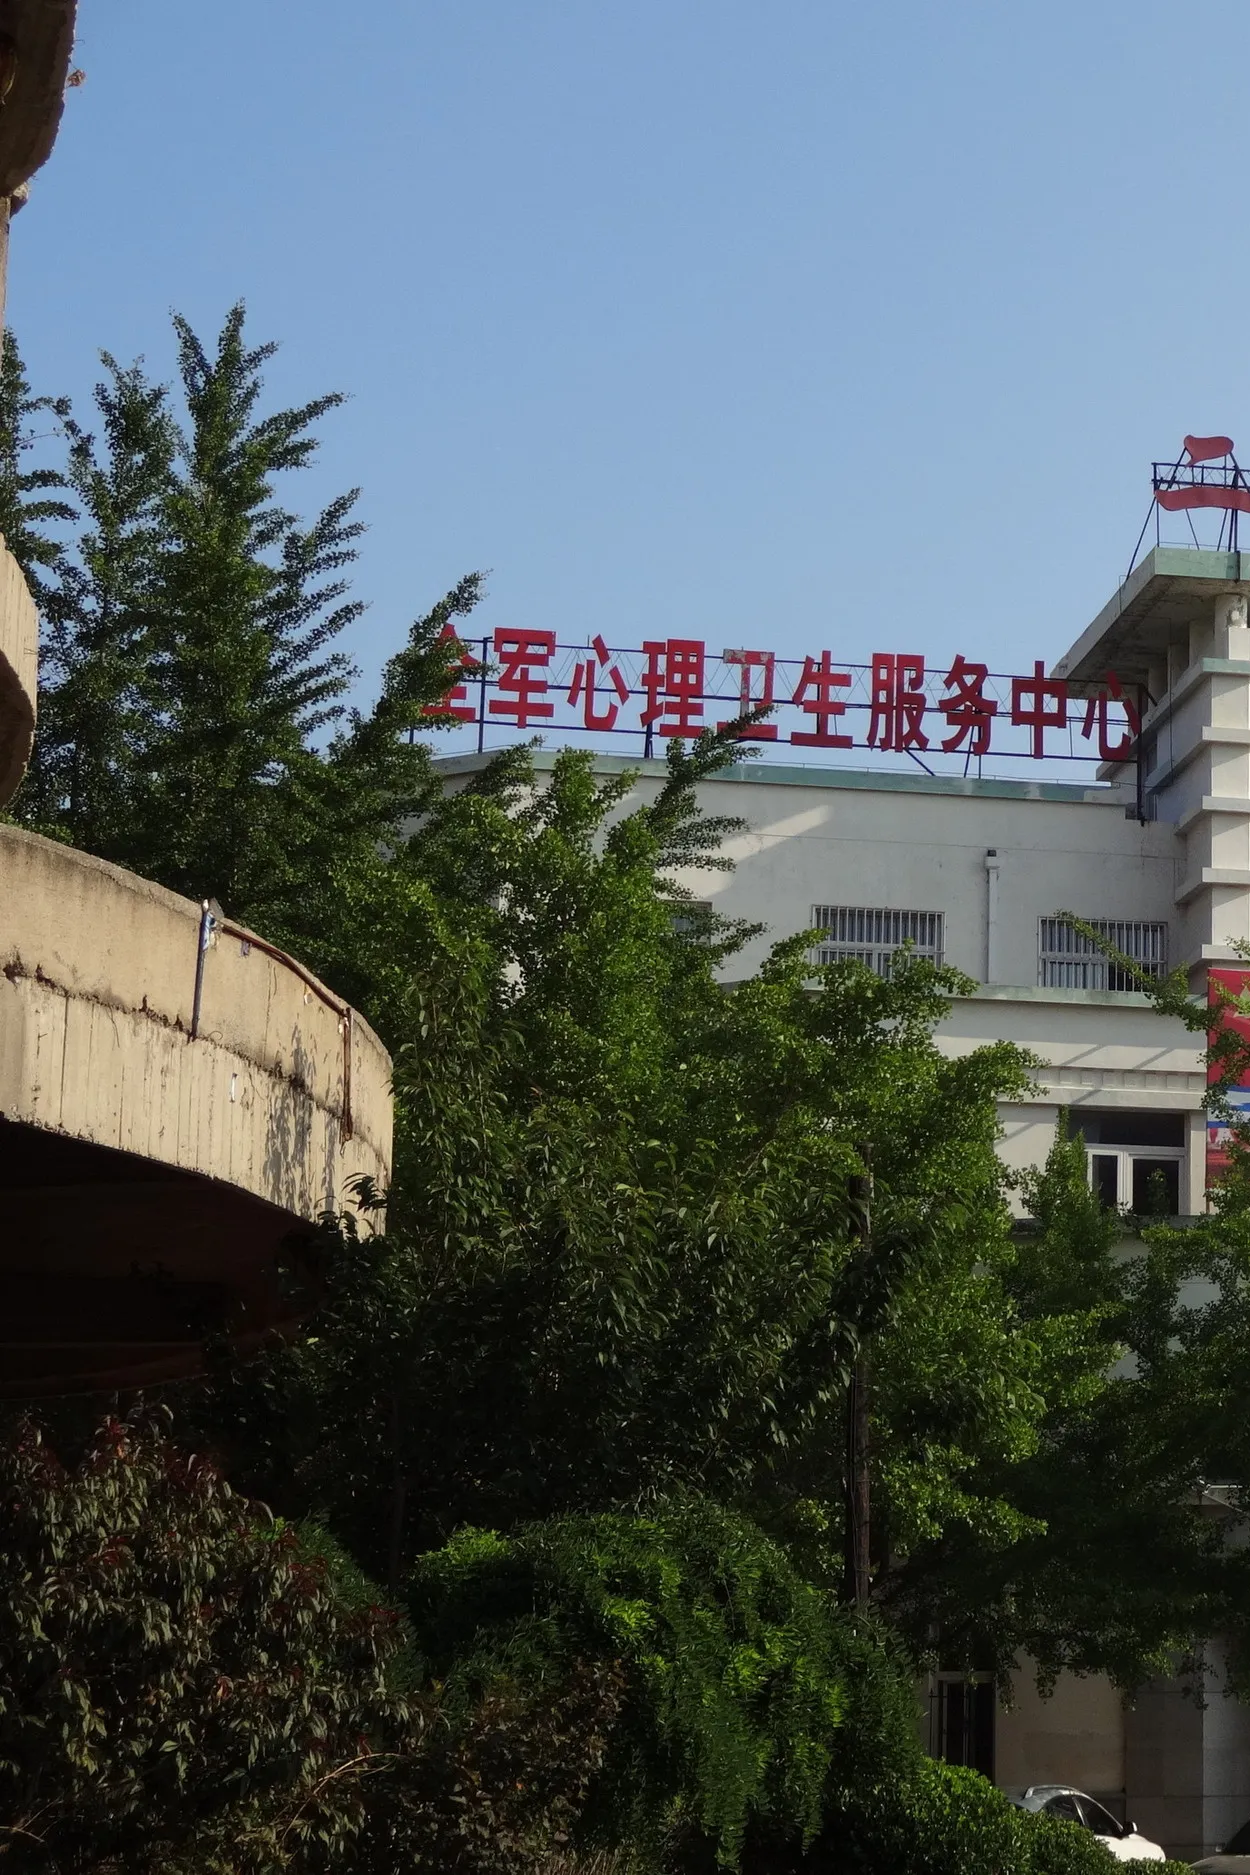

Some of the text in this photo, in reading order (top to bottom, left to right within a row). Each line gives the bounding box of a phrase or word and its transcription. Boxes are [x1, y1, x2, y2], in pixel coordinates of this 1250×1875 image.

[420, 624, 1141, 761] 全军心理卫生服务中心
